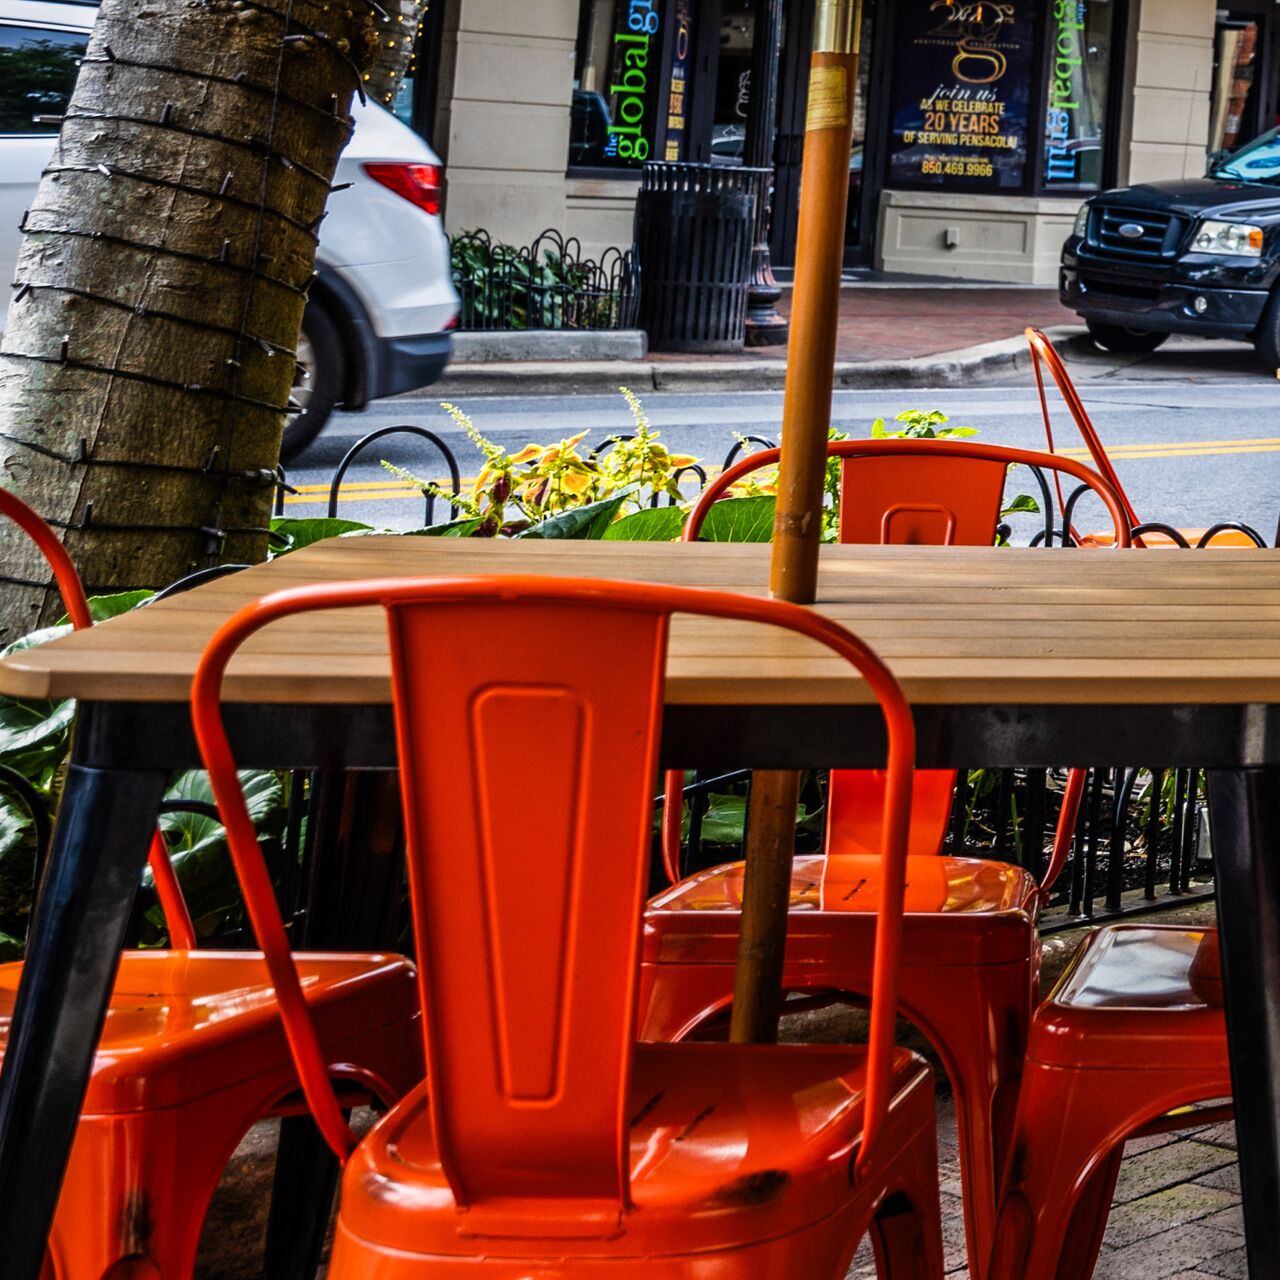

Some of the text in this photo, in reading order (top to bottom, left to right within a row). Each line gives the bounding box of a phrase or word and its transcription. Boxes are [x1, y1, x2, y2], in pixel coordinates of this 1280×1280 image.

[1053, 0, 1086, 110] global
[608, 33, 650, 161] global
[928, 83, 971, 105] join
[935, 99, 950, 112] WE
[951, 100, 1005, 115] CELEBRATE
[924, 111, 1000, 134] 20 YEARS
[604, 134, 619, 157] the
[903, 130, 917, 143] OF
[918, 131, 959, 145] SERVING
